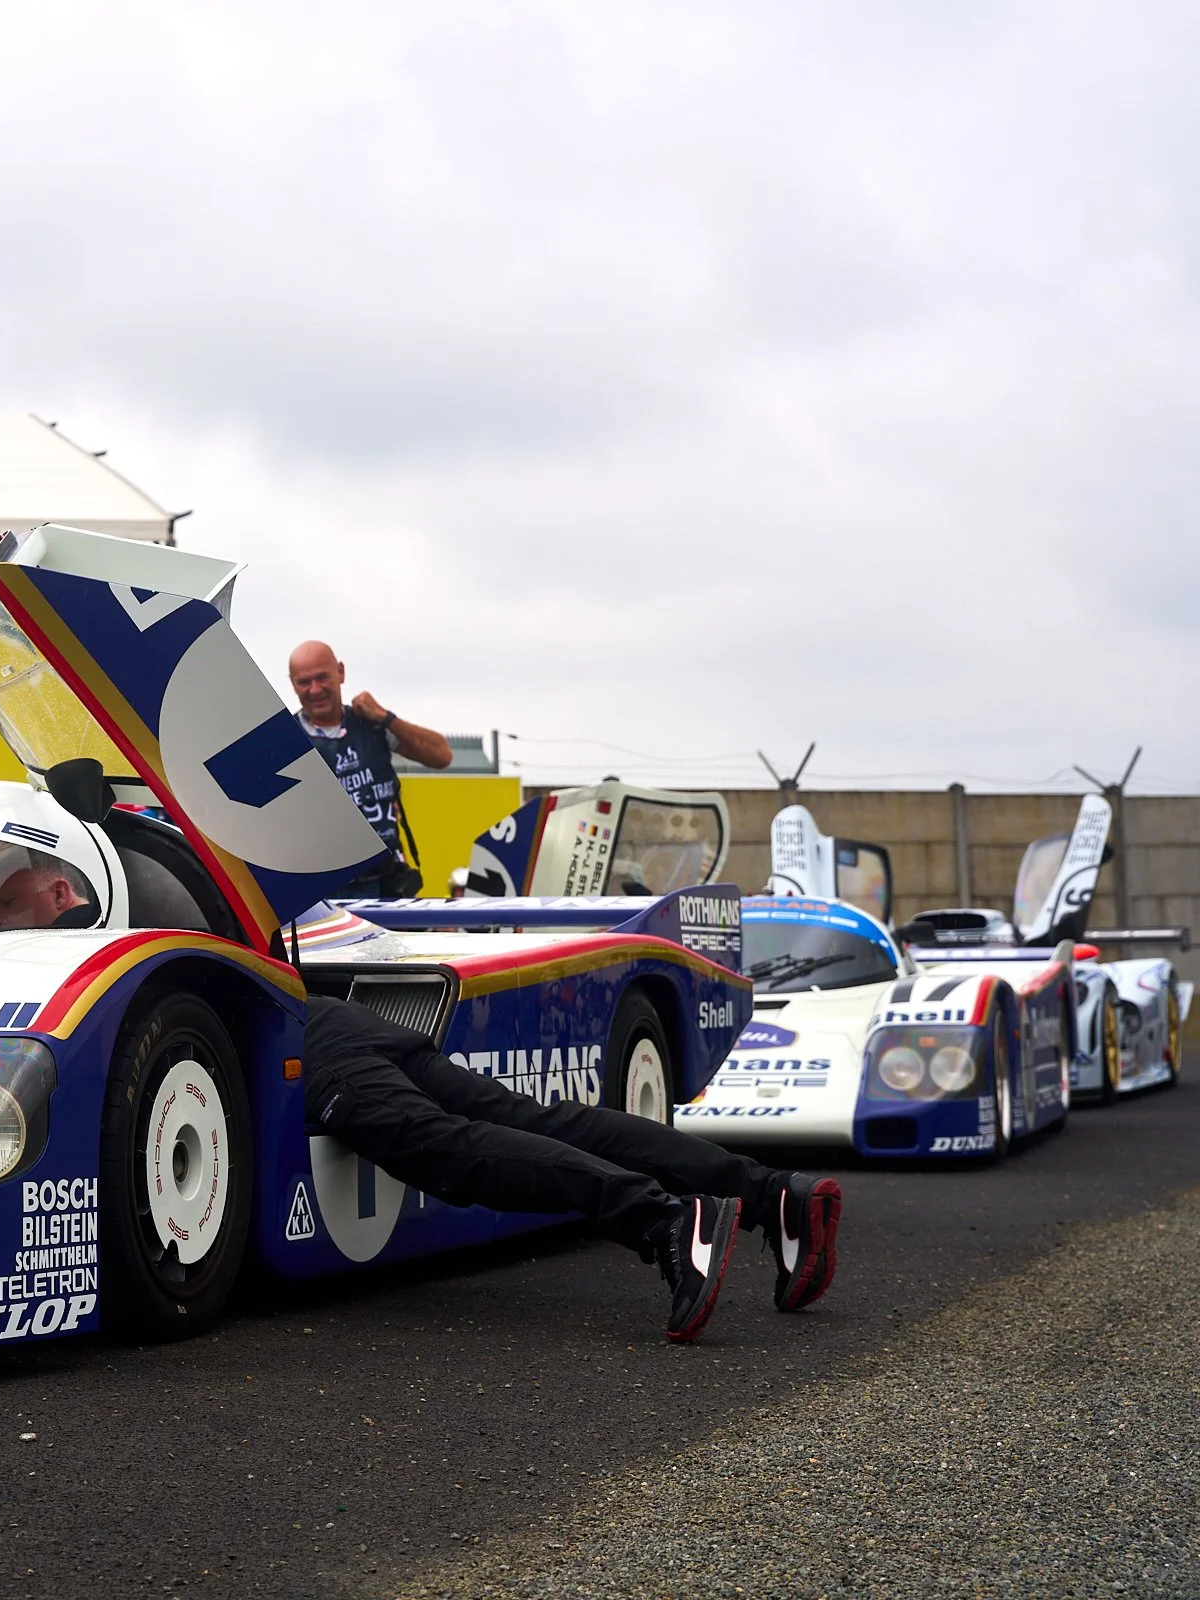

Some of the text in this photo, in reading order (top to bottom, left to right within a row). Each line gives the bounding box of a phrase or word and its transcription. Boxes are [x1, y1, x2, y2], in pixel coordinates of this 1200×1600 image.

[589, 860, 604, 893] BELL
[679, 895, 740, 926] ROTHMANS
[681, 933, 741, 952] PORSCHE
[699, 1000, 733, 1029] Shell
[185, 1083, 207, 1108] 956
[155, 1089, 177, 1196] PORSCHE
[22, 1177, 98, 1213] BOSCH
[198, 1128, 219, 1232] PORSCHE
[22, 1211, 98, 1247] BILSTEIN
[15, 1243, 98, 1272] SCHMITTHELM
